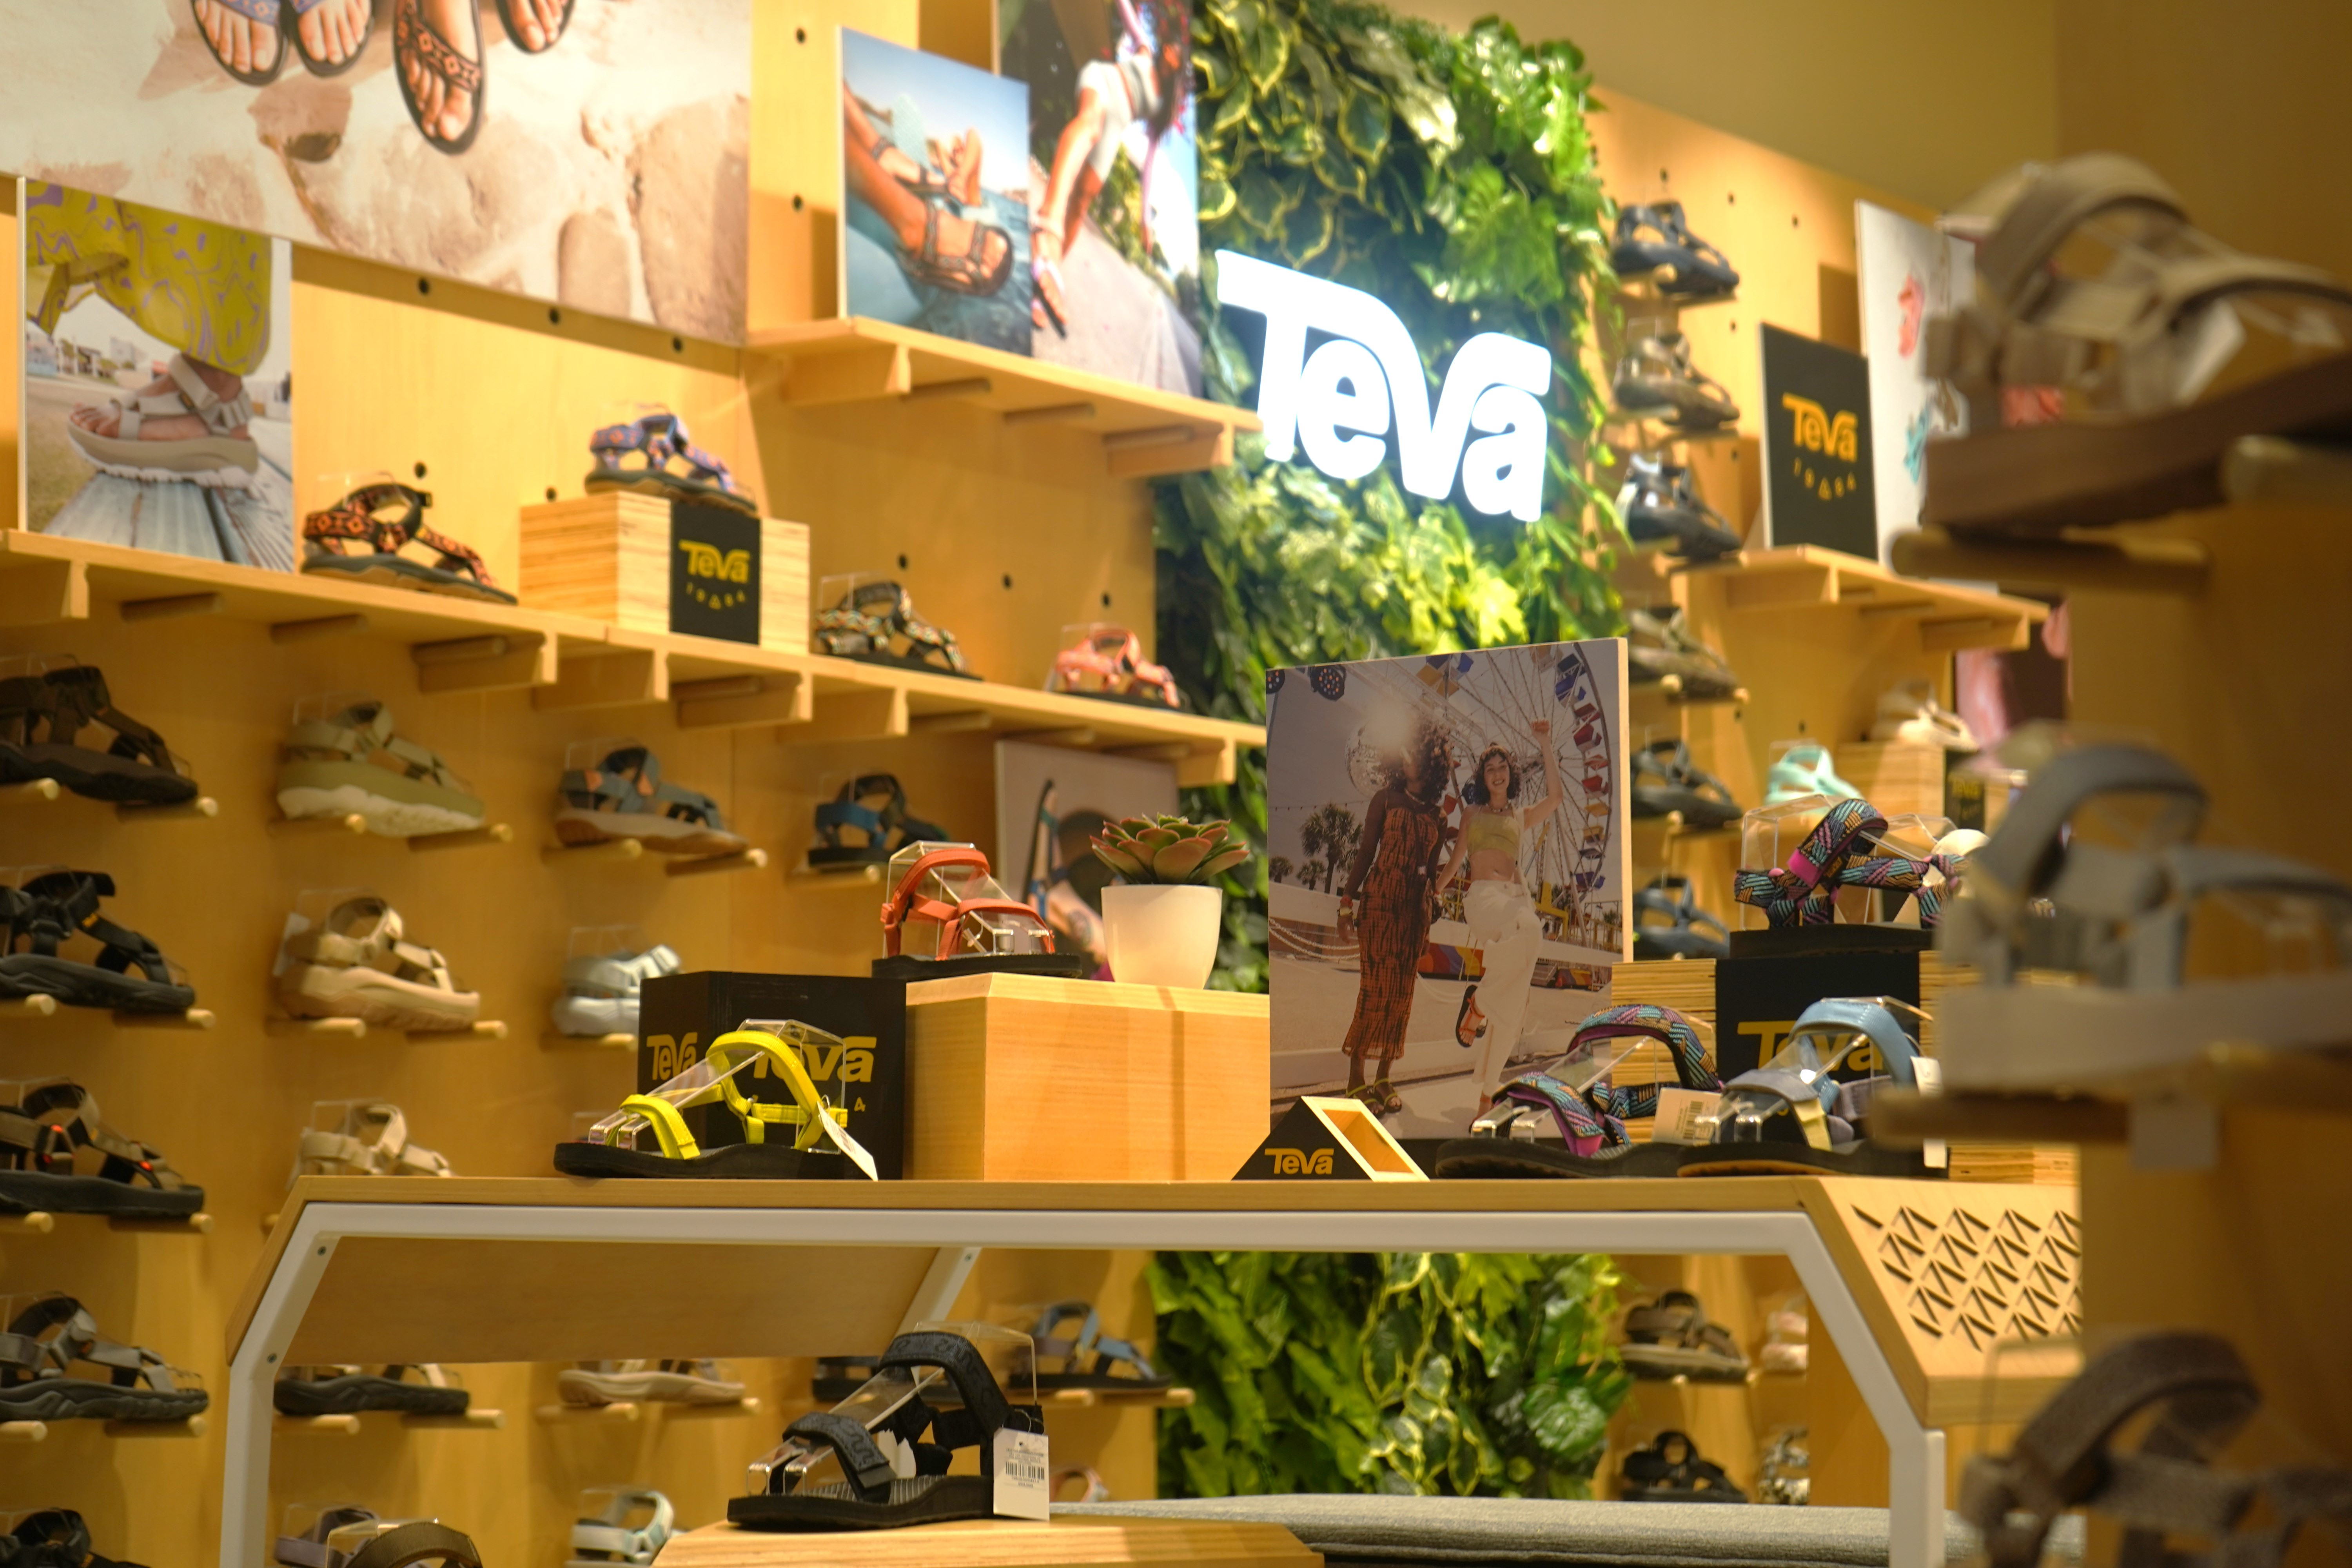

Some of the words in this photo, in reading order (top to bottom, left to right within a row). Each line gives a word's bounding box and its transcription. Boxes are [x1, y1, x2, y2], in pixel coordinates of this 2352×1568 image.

[1216, 249, 1552, 522] Teva
[1782, 392, 1858, 463] Teva
[679, 539, 750, 583] Teva
[1265, 1148, 1334, 1174] Teva
